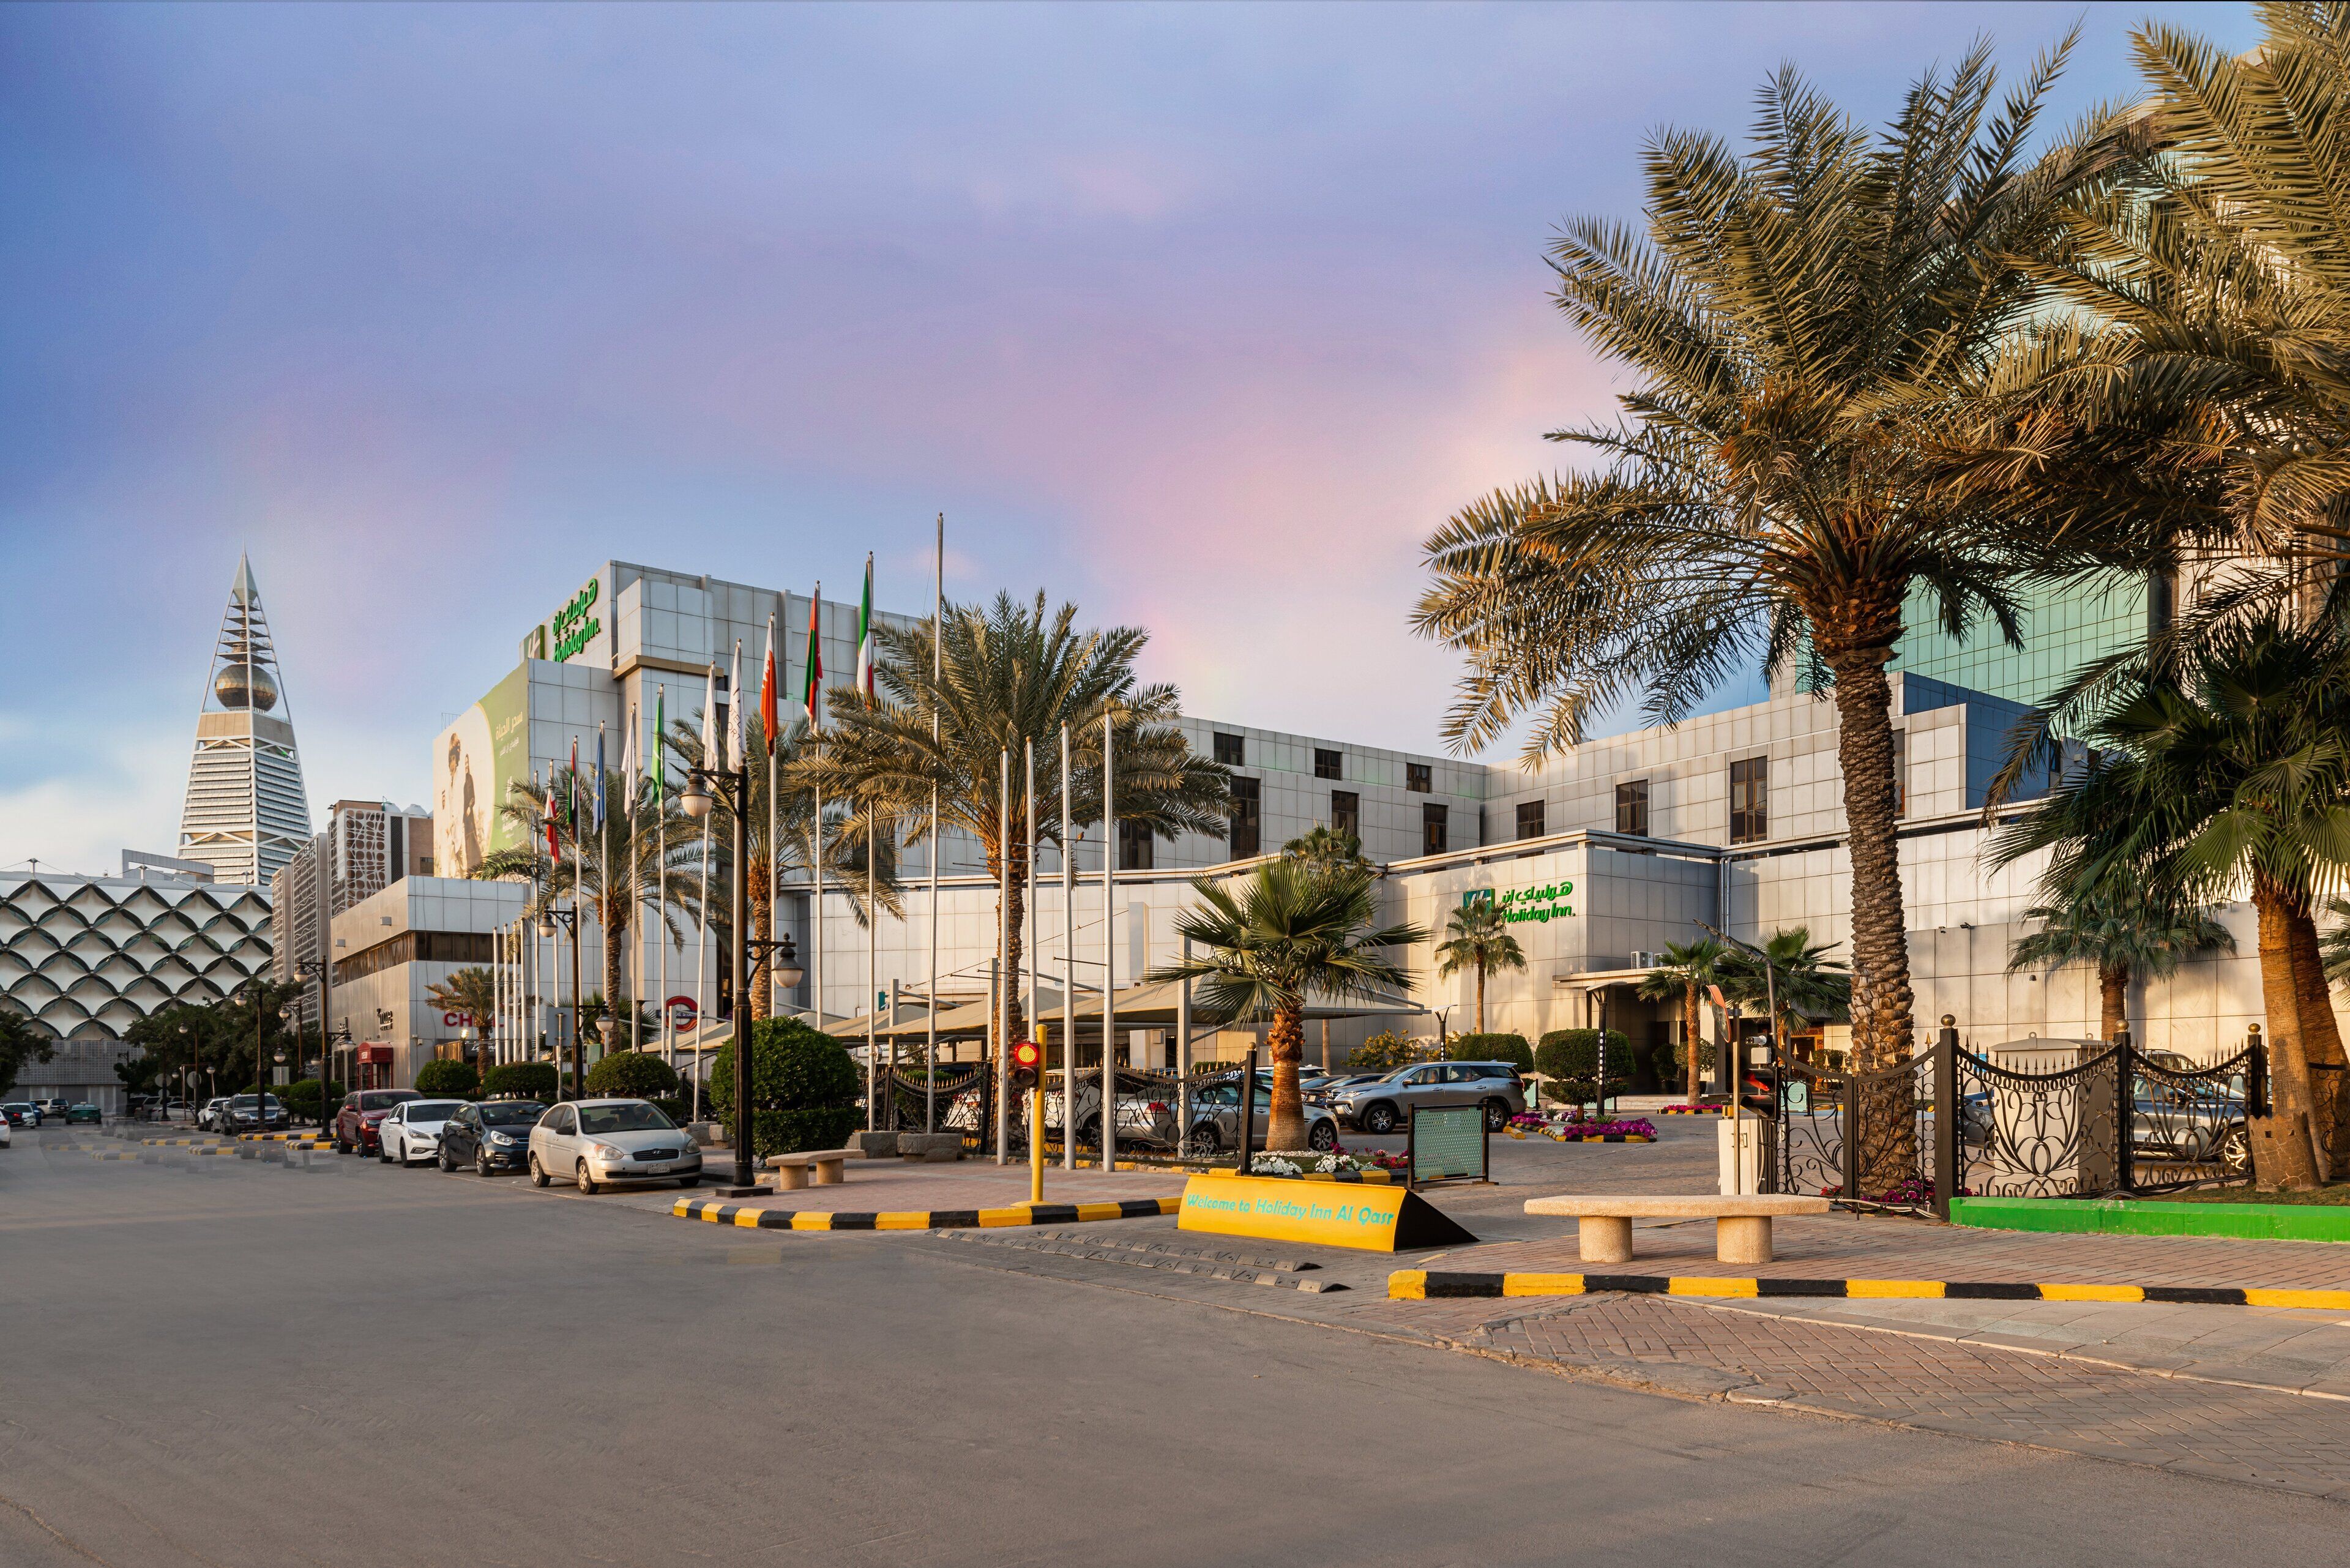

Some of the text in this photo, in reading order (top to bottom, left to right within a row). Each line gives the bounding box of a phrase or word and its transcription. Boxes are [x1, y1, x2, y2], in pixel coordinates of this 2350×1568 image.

[553, 629, 584, 662] Holiday
[1501, 906, 1550, 923] Holiday
[1187, 1194, 1394, 1225] Welcome to Holiday Inn Al Qasr
